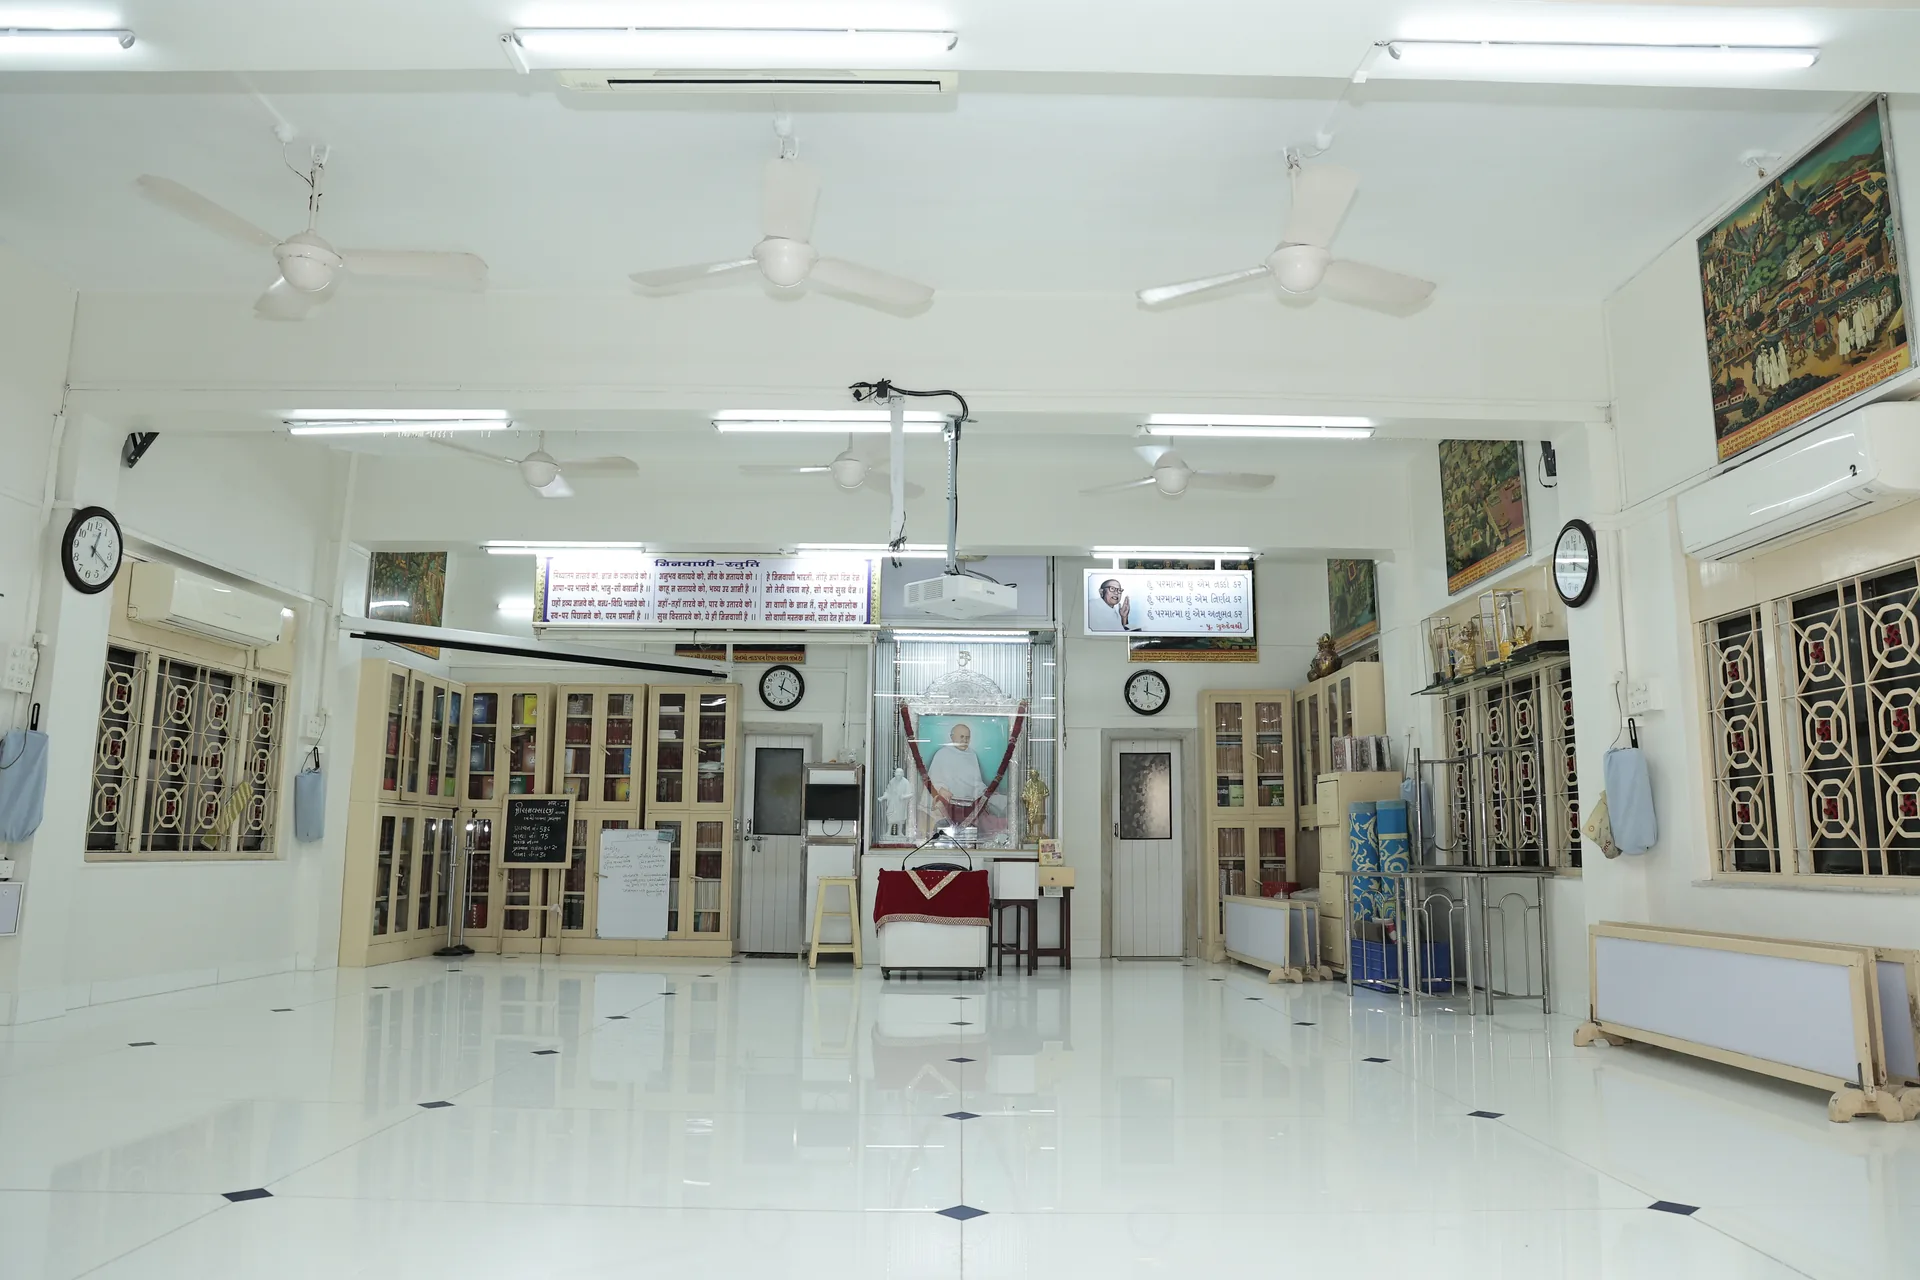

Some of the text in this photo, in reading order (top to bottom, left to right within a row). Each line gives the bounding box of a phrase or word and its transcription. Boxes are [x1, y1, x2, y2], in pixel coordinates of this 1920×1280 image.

[1849, 464, 1858, 477] 2
[95, 521, 102, 531] 12
[79, 529, 86, 538] 10
[654, 559, 760, 569] जिनवाणी-स्तुति
[745, 571, 752, 580] को
[1195, 594, 1208, 603] એમ
[745, 599, 752, 608] को
[1193, 609, 1205, 618] એમ
